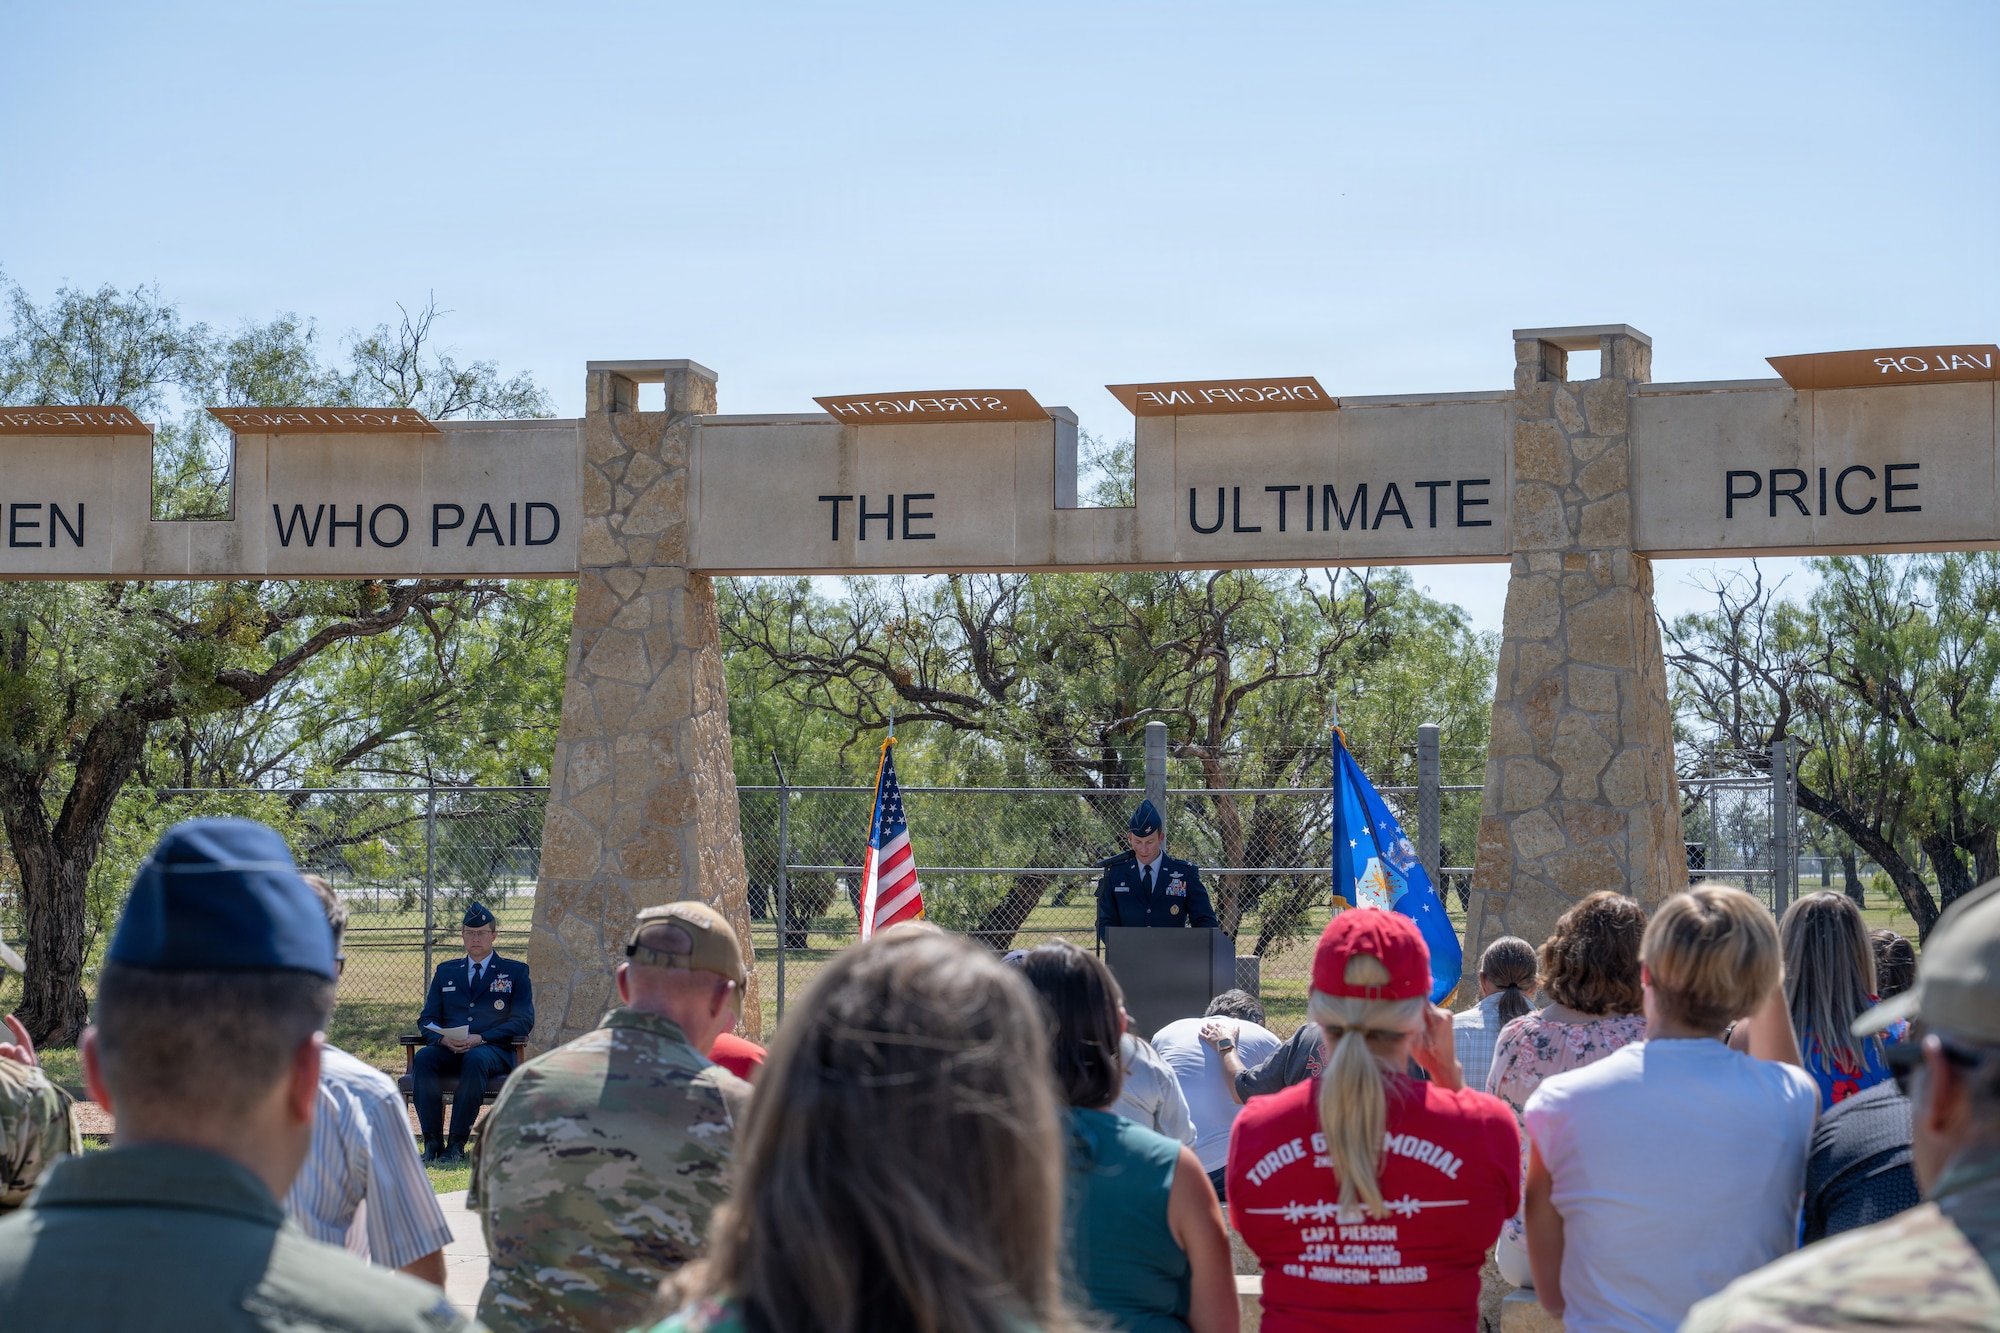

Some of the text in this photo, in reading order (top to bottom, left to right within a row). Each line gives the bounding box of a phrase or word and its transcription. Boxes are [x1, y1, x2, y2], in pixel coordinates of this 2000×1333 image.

[0, 462, 1922, 549] EN WHO PAID THE ULTIMATE PRICE
[1310, 1131, 1328, 1154] 6
[1382, 1130, 1464, 1180] MORIAL
